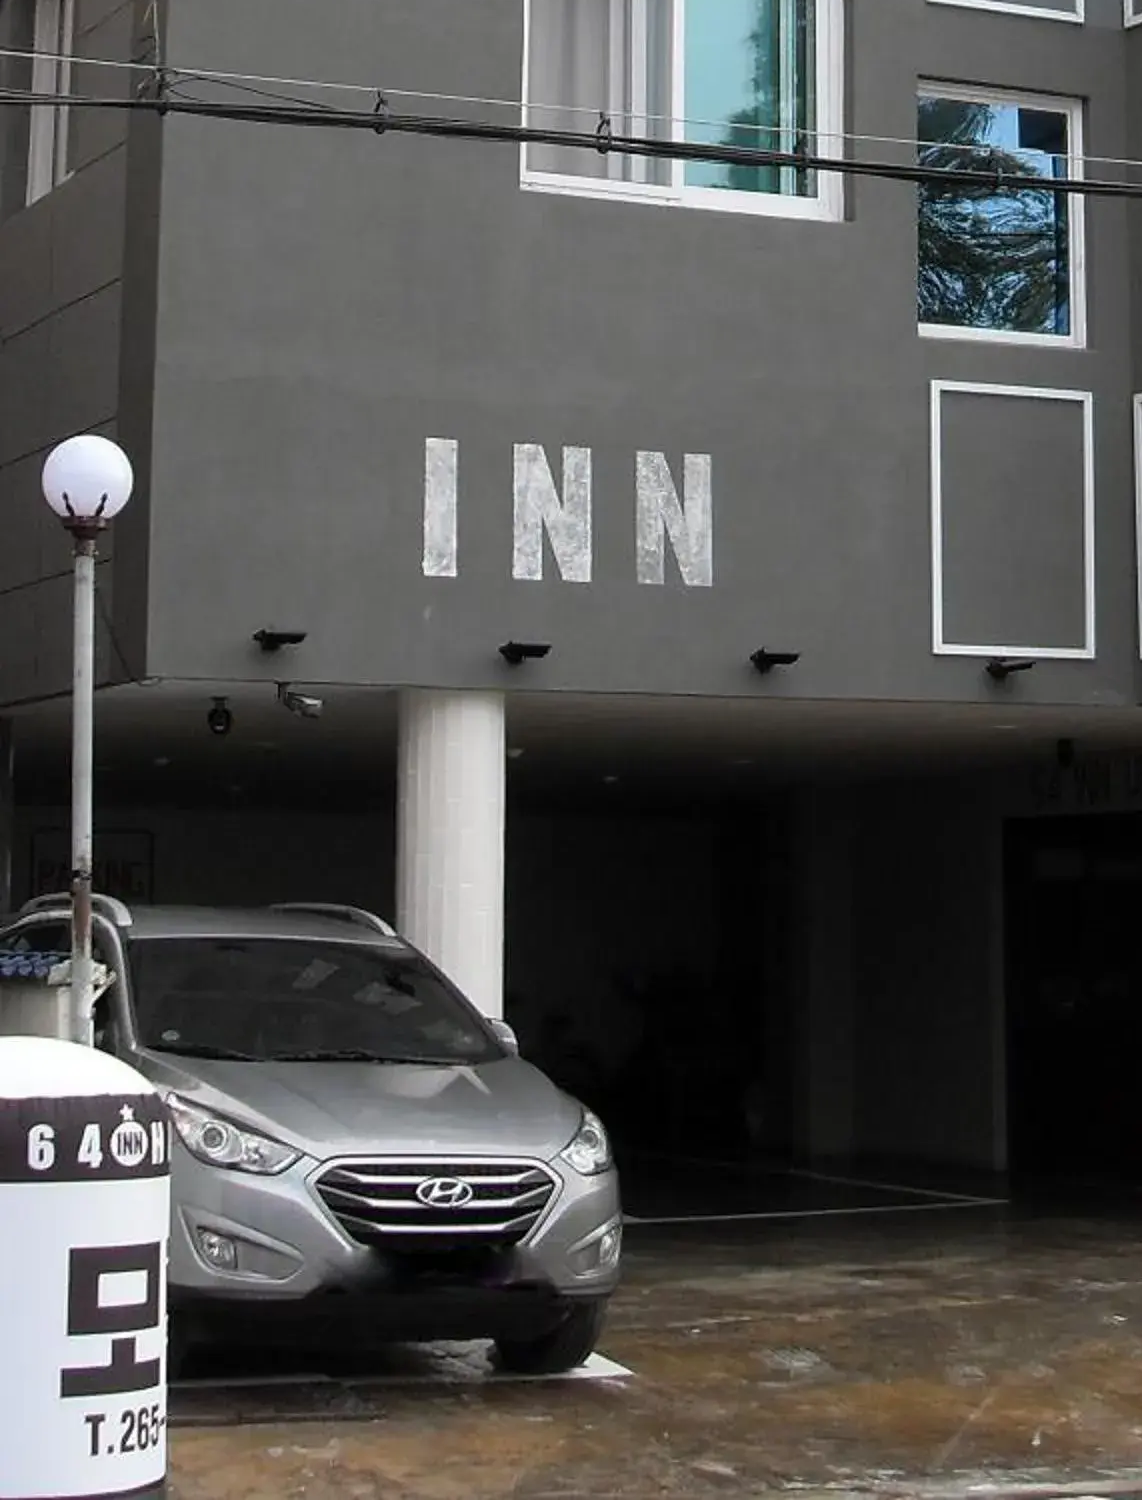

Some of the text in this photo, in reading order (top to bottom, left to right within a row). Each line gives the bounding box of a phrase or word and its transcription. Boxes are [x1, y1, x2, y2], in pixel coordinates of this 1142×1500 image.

[422, 437, 712, 586] INN
[116, 1131, 143, 1156] INN
[60, 1241, 161, 1398] 모
